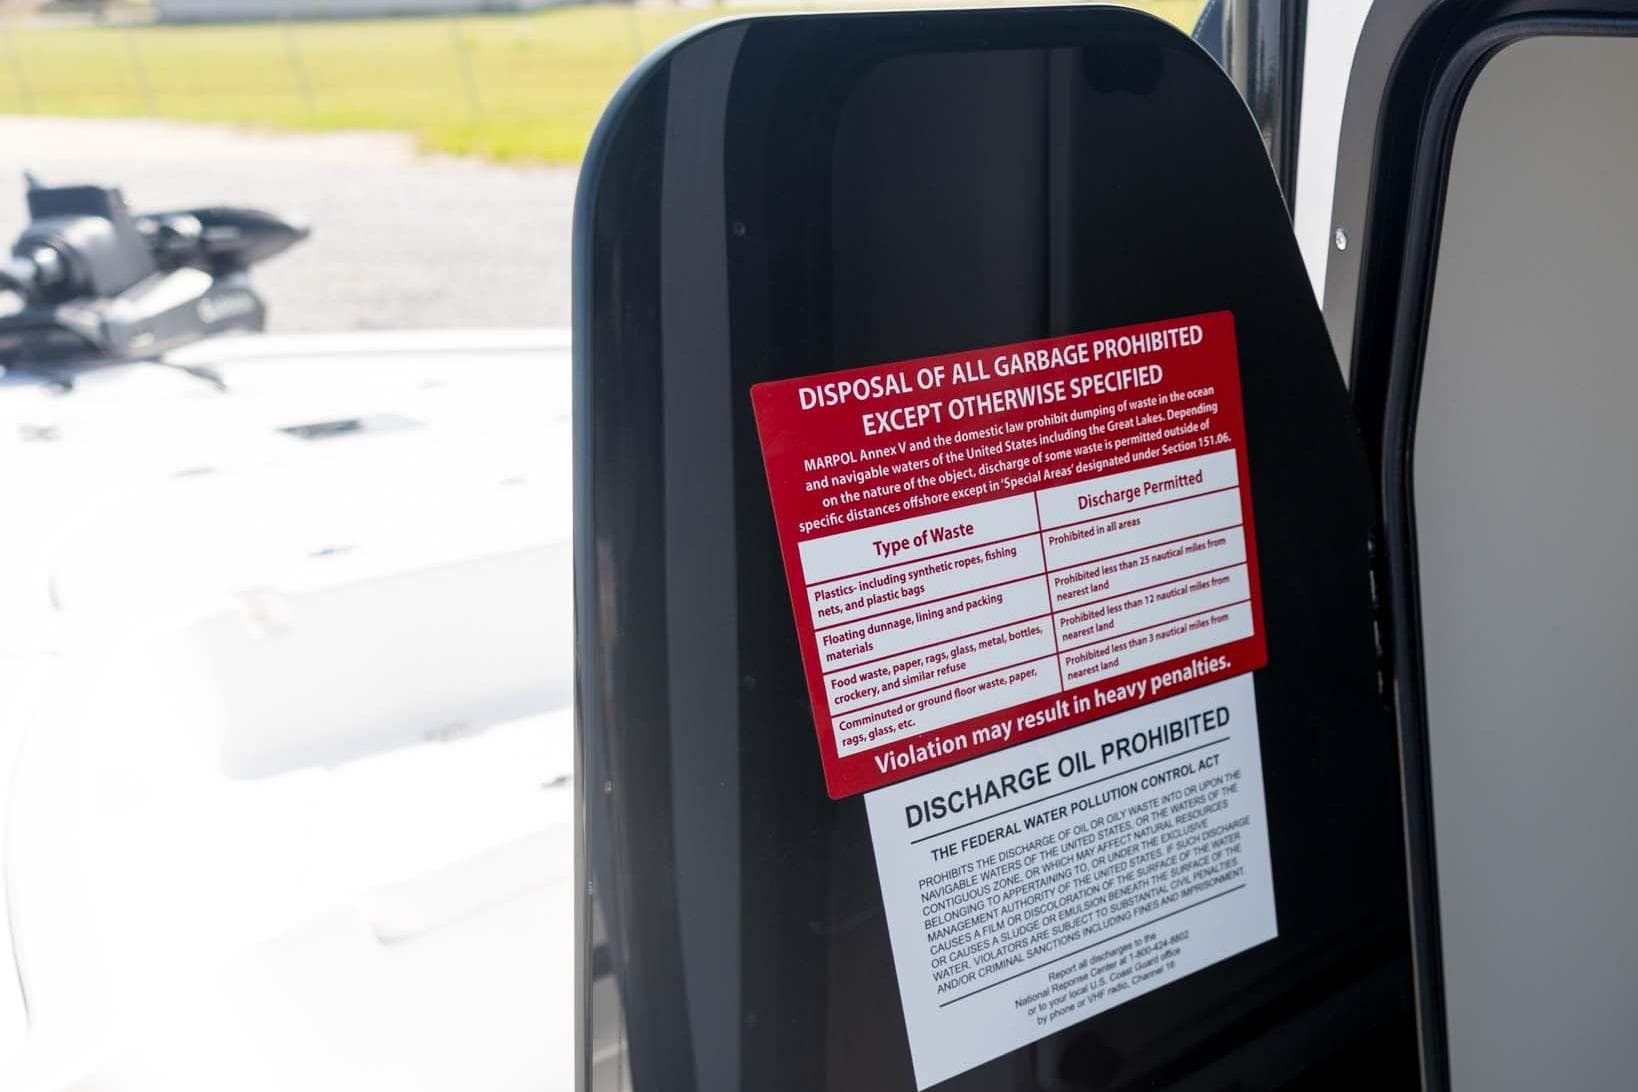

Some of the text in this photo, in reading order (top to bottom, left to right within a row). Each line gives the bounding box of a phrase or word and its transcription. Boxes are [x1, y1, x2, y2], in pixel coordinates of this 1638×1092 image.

[798, 325, 1203, 410] DISPOSAL OF ALL GARBAGE PROHIBITED
[803, 386, 1215, 472] MARPOL Annex V and the domestic law prohibit dumping of waste in the ocean
[862, 364, 1163, 436] EXCEPT OTHERWISE SPECIFIED
[805, 402, 1219, 492] and navigable waters of the United States including the Great Lakes. Depending
[822, 417, 1210, 508] on the nature of the object, discharge of some waste is permitted outside of
[798, 512, 845, 534] specific
[846, 502, 901, 522] distances
[902, 492, 950, 510] offshore
[951, 483, 988, 500] except
[988, 480, 1000, 492] in
[1075, 451, 1131, 474] designated
[1131, 447, 1161, 462] under
[1161, 440, 1197, 456] Section
[1198, 431, 1232, 448] 151.06.
[1077, 468, 1204, 510] Discharge Permitted
[872, 523, 974, 559] Type of Waste
[1048, 518, 1141, 546] Prohibited in all areas
[1054, 538, 1227, 587] Prohibited less than 25 nautical miles from
[814, 547, 1017, 602] Plastics- including synthetic ropes, fishing
[817, 584, 925, 618] nets, and plastic bags
[1056, 579, 1110, 602] nearest land
[822, 593, 1004, 647] Floating dunnage, lining and packing
[825, 641, 874, 662] materials
[830, 626, 1043, 690] Food waste, paper, rags, glass, metal, bottles,
[834, 662, 967, 705] crockery, and similar refuse
[838, 668, 1038, 731] Comminuted or ground floor waste, paper,
[874, 655, 1232, 774] Violation may result in heavy penalties.
[842, 719, 916, 747] rags, glass, etc.
[905, 706, 1230, 829] DISCHARGE OIL PROHIBITED
[918, 769, 1241, 891] PROHIBITS THE DISCHARGE OF OIL OR OILY WASTE INTO OR UPON THE
[930, 753, 1220, 862] THE FEDERAL WATER POLLUTION CONTROL ACT
